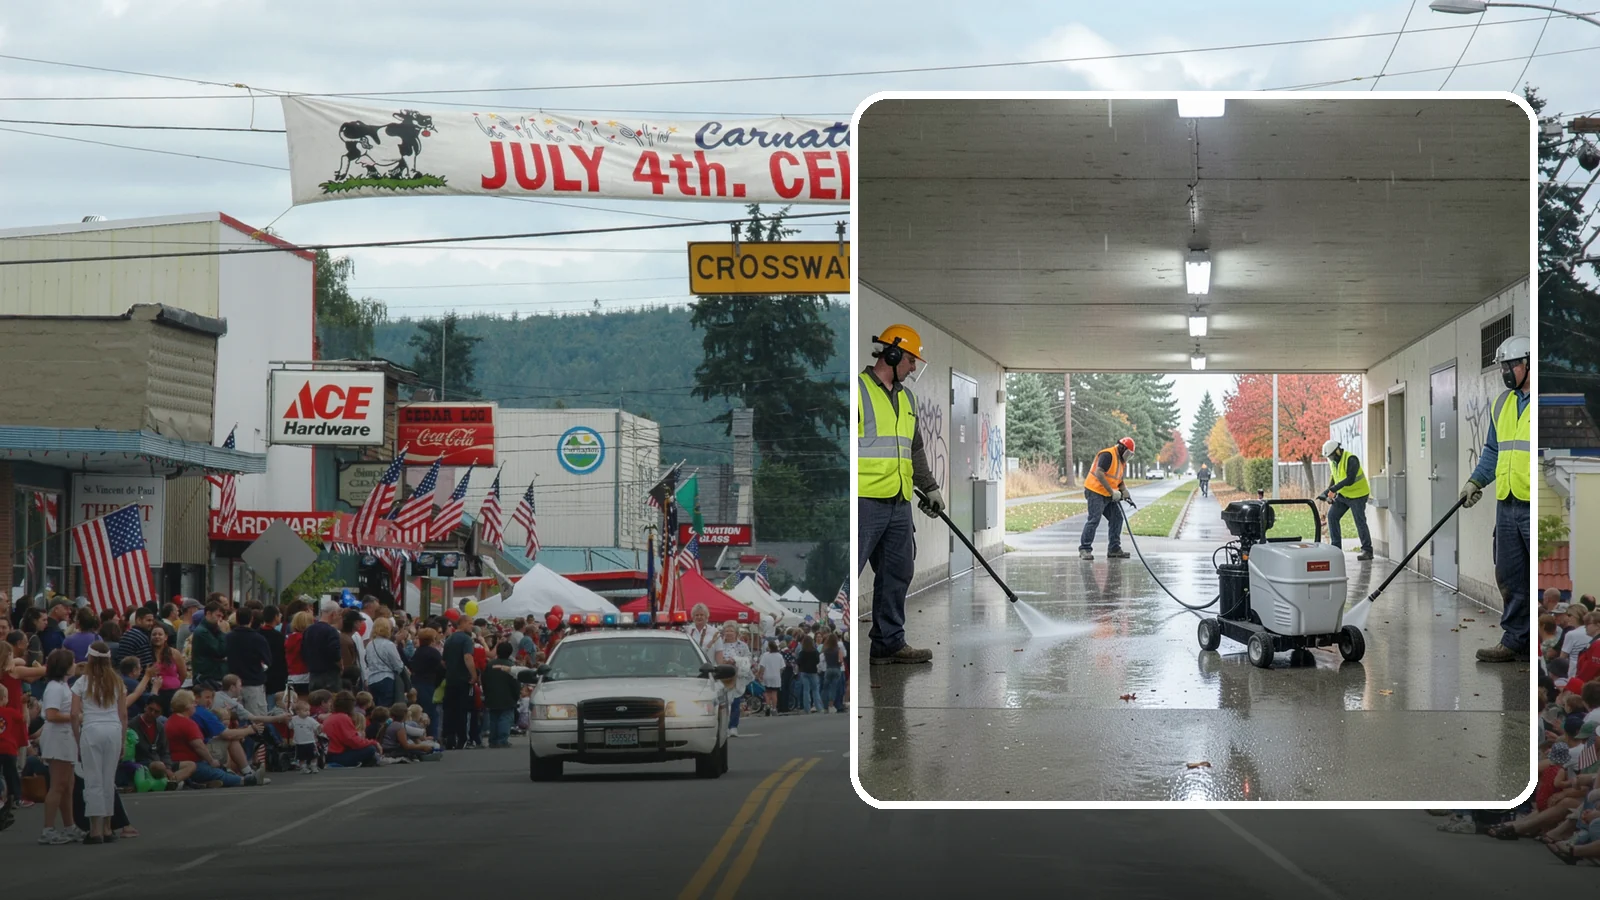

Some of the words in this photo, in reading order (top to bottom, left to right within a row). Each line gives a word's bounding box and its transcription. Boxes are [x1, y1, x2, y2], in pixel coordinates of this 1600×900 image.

[481, 140, 605, 192] JULY
[632, 150, 746, 198] 4th.
[697, 254, 850, 280] CROSSWA
[283, 380, 374, 420] ACE
[406, 409, 452, 422] CEDAR
[461, 409, 485, 422] LOG
[283, 421, 371, 436] Hardware
[354, 467, 386, 479] Simpl
[96, 484, 124, 494] Vincent
[127, 485, 136, 495] de
[138, 486, 155, 496] Paul
[688, 526, 741, 535] CRNATION
